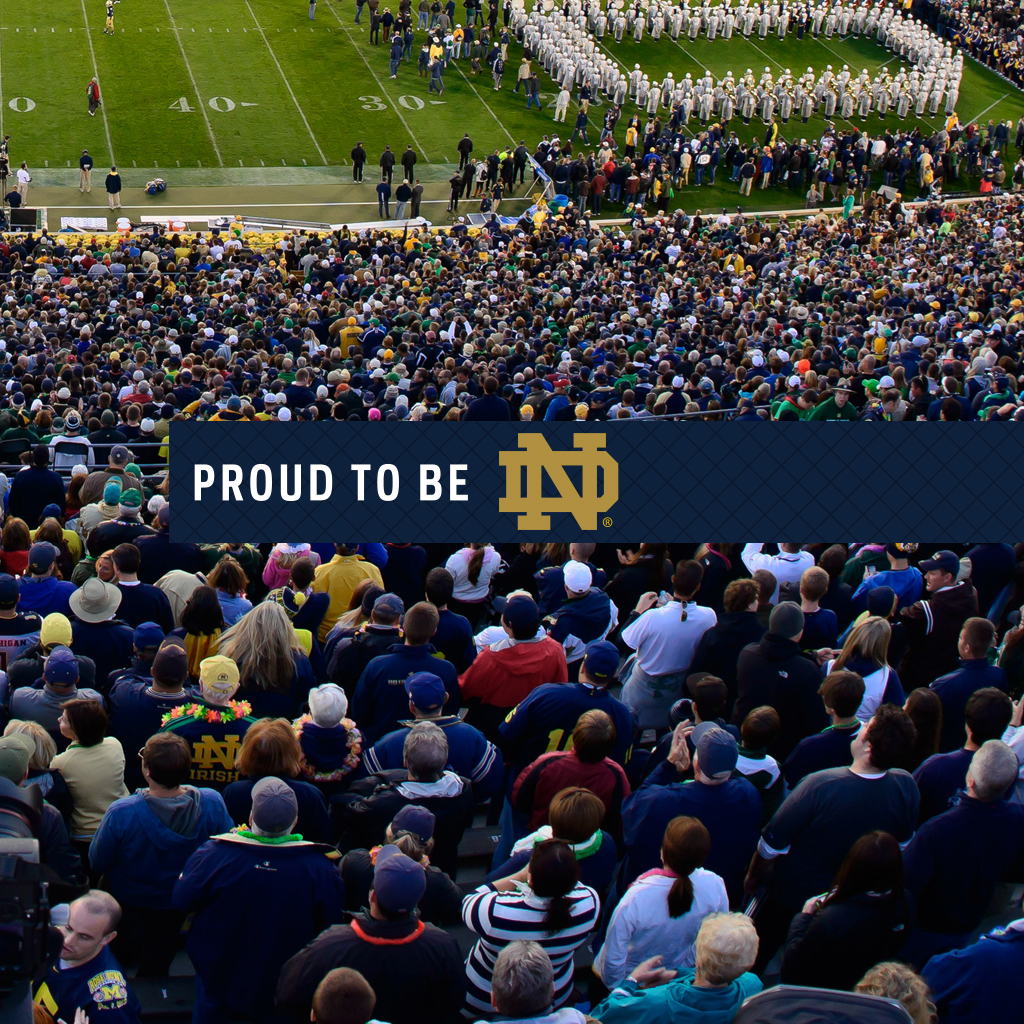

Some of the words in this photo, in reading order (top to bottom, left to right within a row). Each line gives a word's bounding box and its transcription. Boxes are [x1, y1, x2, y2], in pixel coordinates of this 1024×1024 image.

[168, 96, 237, 113] 40
[358, 94, 426, 111] 30
[191, 734, 243, 771] ND
[189, 769, 240, 783] IRISH
[100, 983, 123, 1001] M
